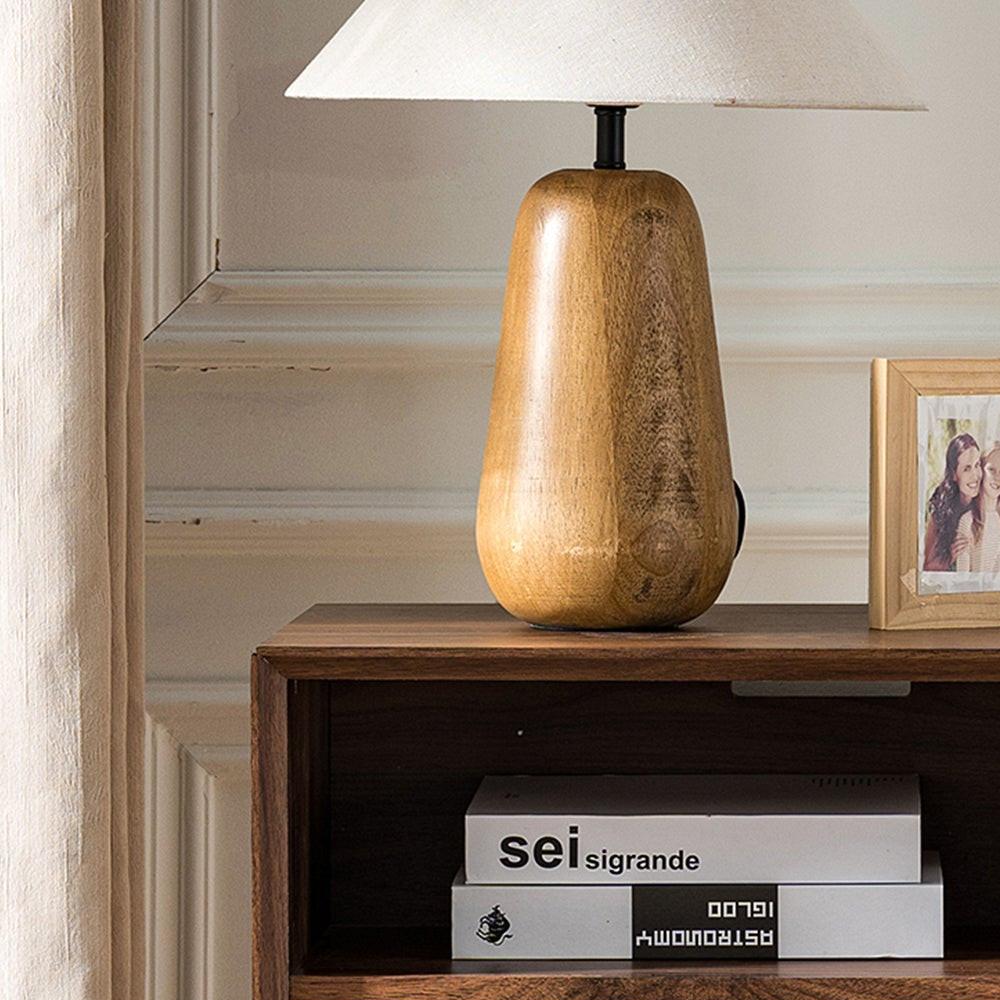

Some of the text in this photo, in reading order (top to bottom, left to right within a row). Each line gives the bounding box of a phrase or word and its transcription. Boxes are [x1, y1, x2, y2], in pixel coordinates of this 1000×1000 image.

[499, 825, 700, 876] sei sigrande
[708, 901, 774, 918] IGLOO
[635, 929, 774, 946] ASTRONOMY
